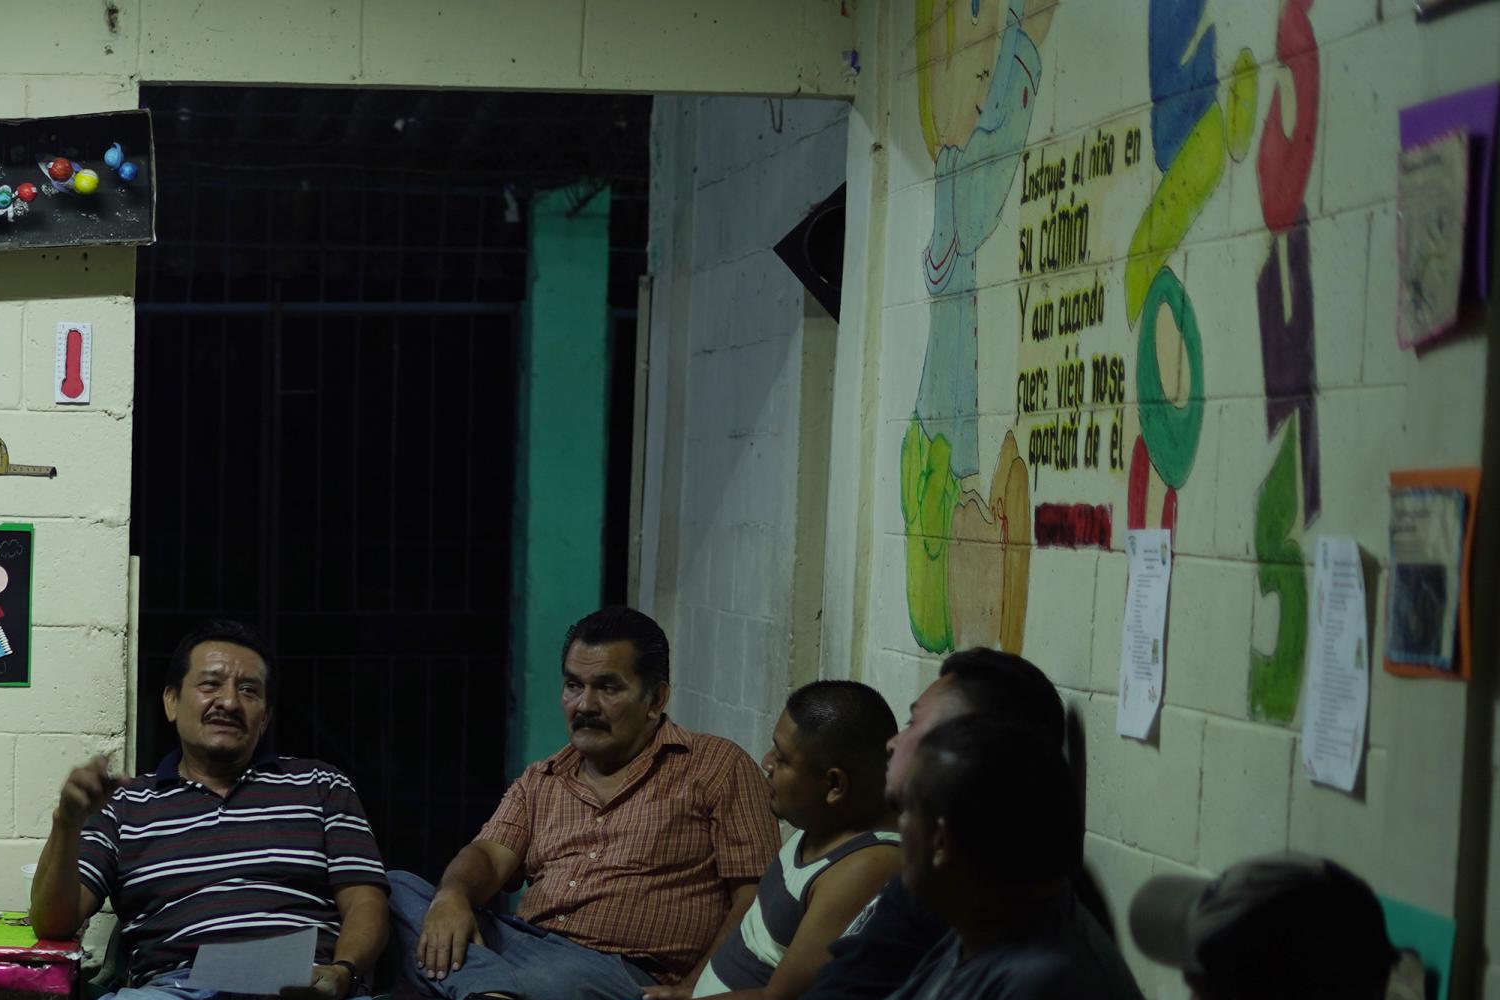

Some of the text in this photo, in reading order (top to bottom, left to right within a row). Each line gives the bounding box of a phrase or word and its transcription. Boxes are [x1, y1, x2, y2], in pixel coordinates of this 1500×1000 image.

[1020, 128, 1141, 214] Instruye al niño en
[1019, 227, 1033, 274] su
[1018, 270, 1105, 343] Y aun cuando
[1016, 367, 1048, 426] fuere
[1057, 344, 1085, 413] viejo
[1028, 412, 1079, 491] apartará
[1084, 411, 1100, 469] de
[1110, 408, 1124, 470] él
